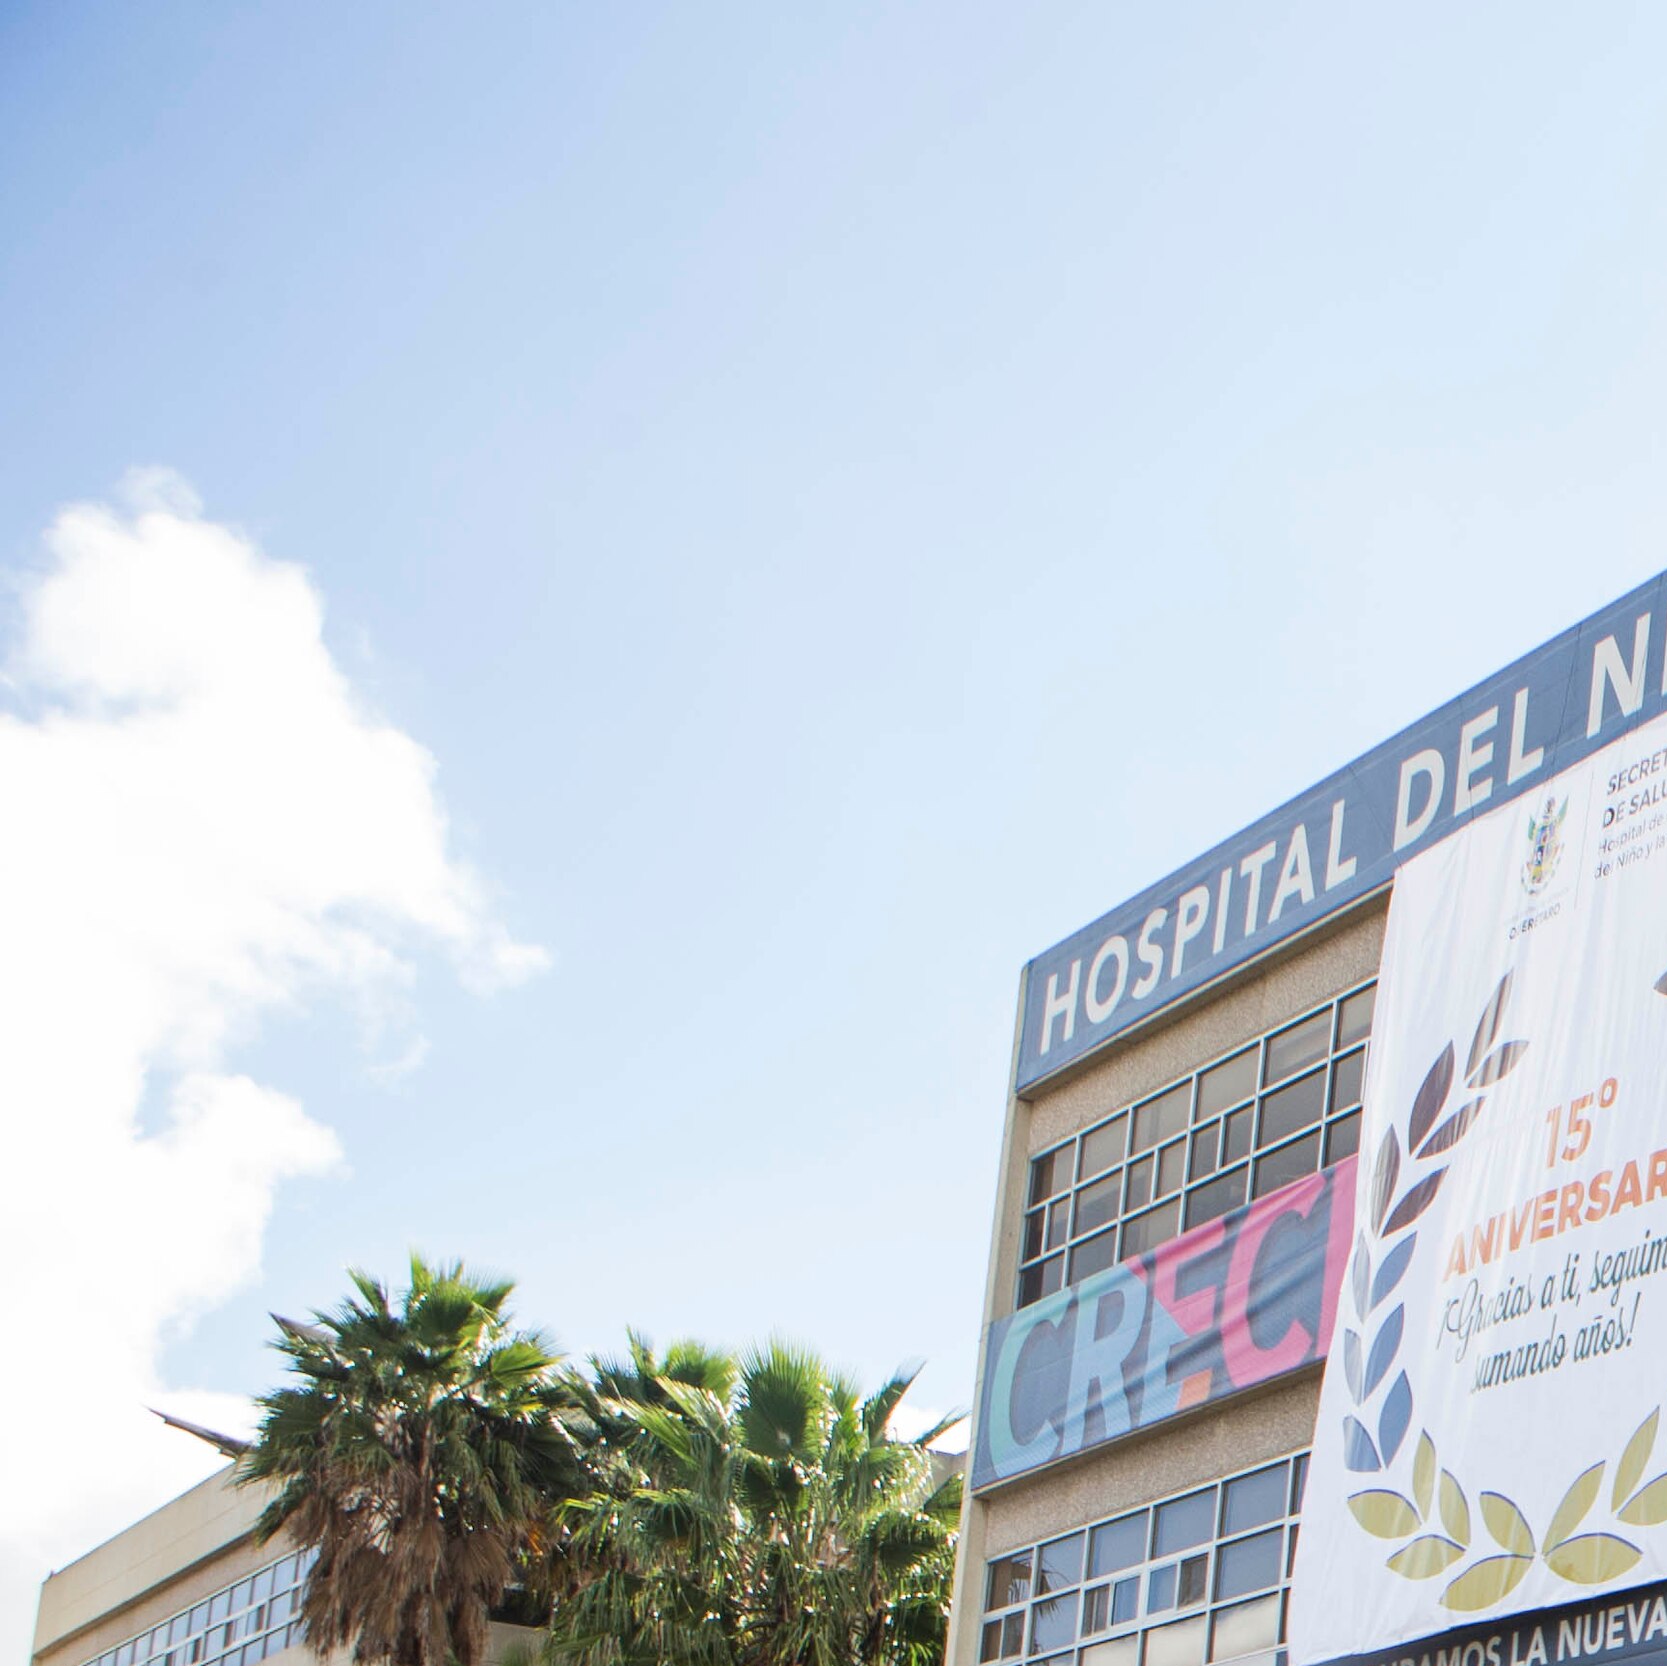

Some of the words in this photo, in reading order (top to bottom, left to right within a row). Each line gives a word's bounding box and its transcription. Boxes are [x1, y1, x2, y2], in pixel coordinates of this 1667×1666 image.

[1599, 820, 1646, 856] Hospital
[1648, 812, 1664, 832] de
[1603, 803, 1625, 829] DE
[1040, 799, 1357, 1055] HOSPITAL
[1393, 687, 1545, 853] DEL
[1616, 843, 1644, 869] Niño
[1655, 834, 1666, 850] la
[1541, 1278, 1555, 1310] a
[1472, 1314, 1566, 1394] sumando
[1573, 1292, 1642, 1361] años!
